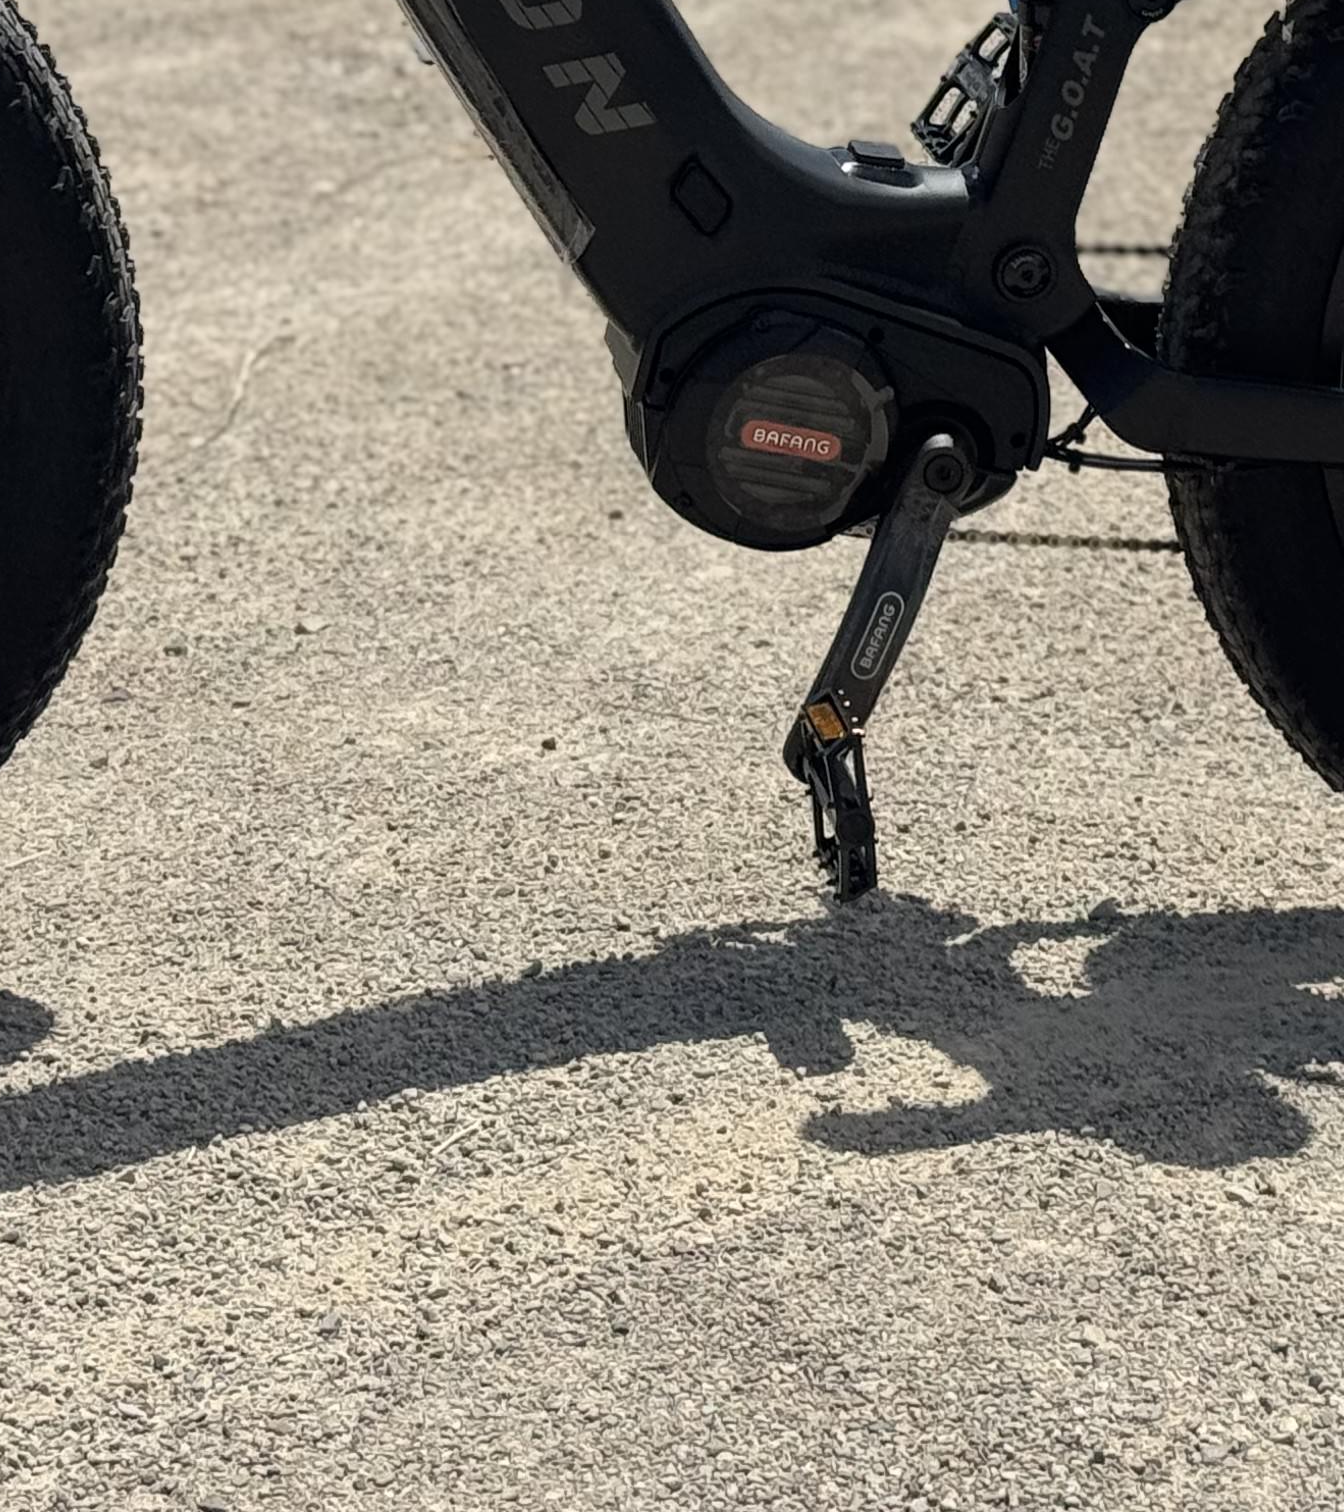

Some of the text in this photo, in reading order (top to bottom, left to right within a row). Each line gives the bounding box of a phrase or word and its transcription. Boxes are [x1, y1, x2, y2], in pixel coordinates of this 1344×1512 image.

[1039, 137, 1061, 170] THE
[753, 428, 831, 455] BAFANG
[859, 604, 896, 669] BAFANG
